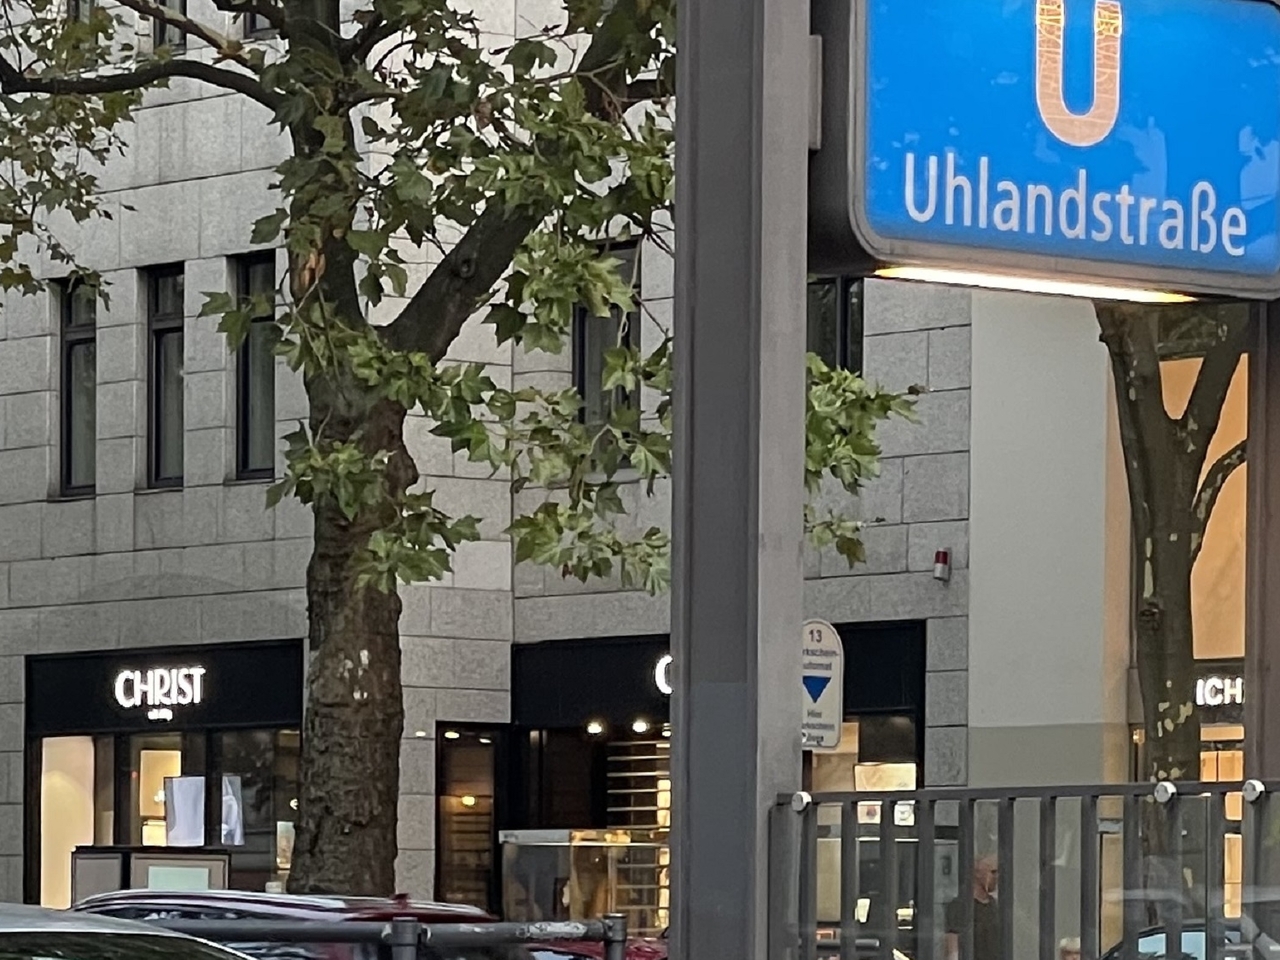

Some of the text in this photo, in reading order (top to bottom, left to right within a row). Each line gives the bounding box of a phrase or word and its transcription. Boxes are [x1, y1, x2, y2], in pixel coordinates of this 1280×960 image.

[1036, 0, 1122, 147] U
[905, 152, 1247, 256] Uhlandstraße
[808, 629, 822, 643] 13
[115, 667, 206, 708] CHRIST
[1195, 677, 1243, 706] ICH
